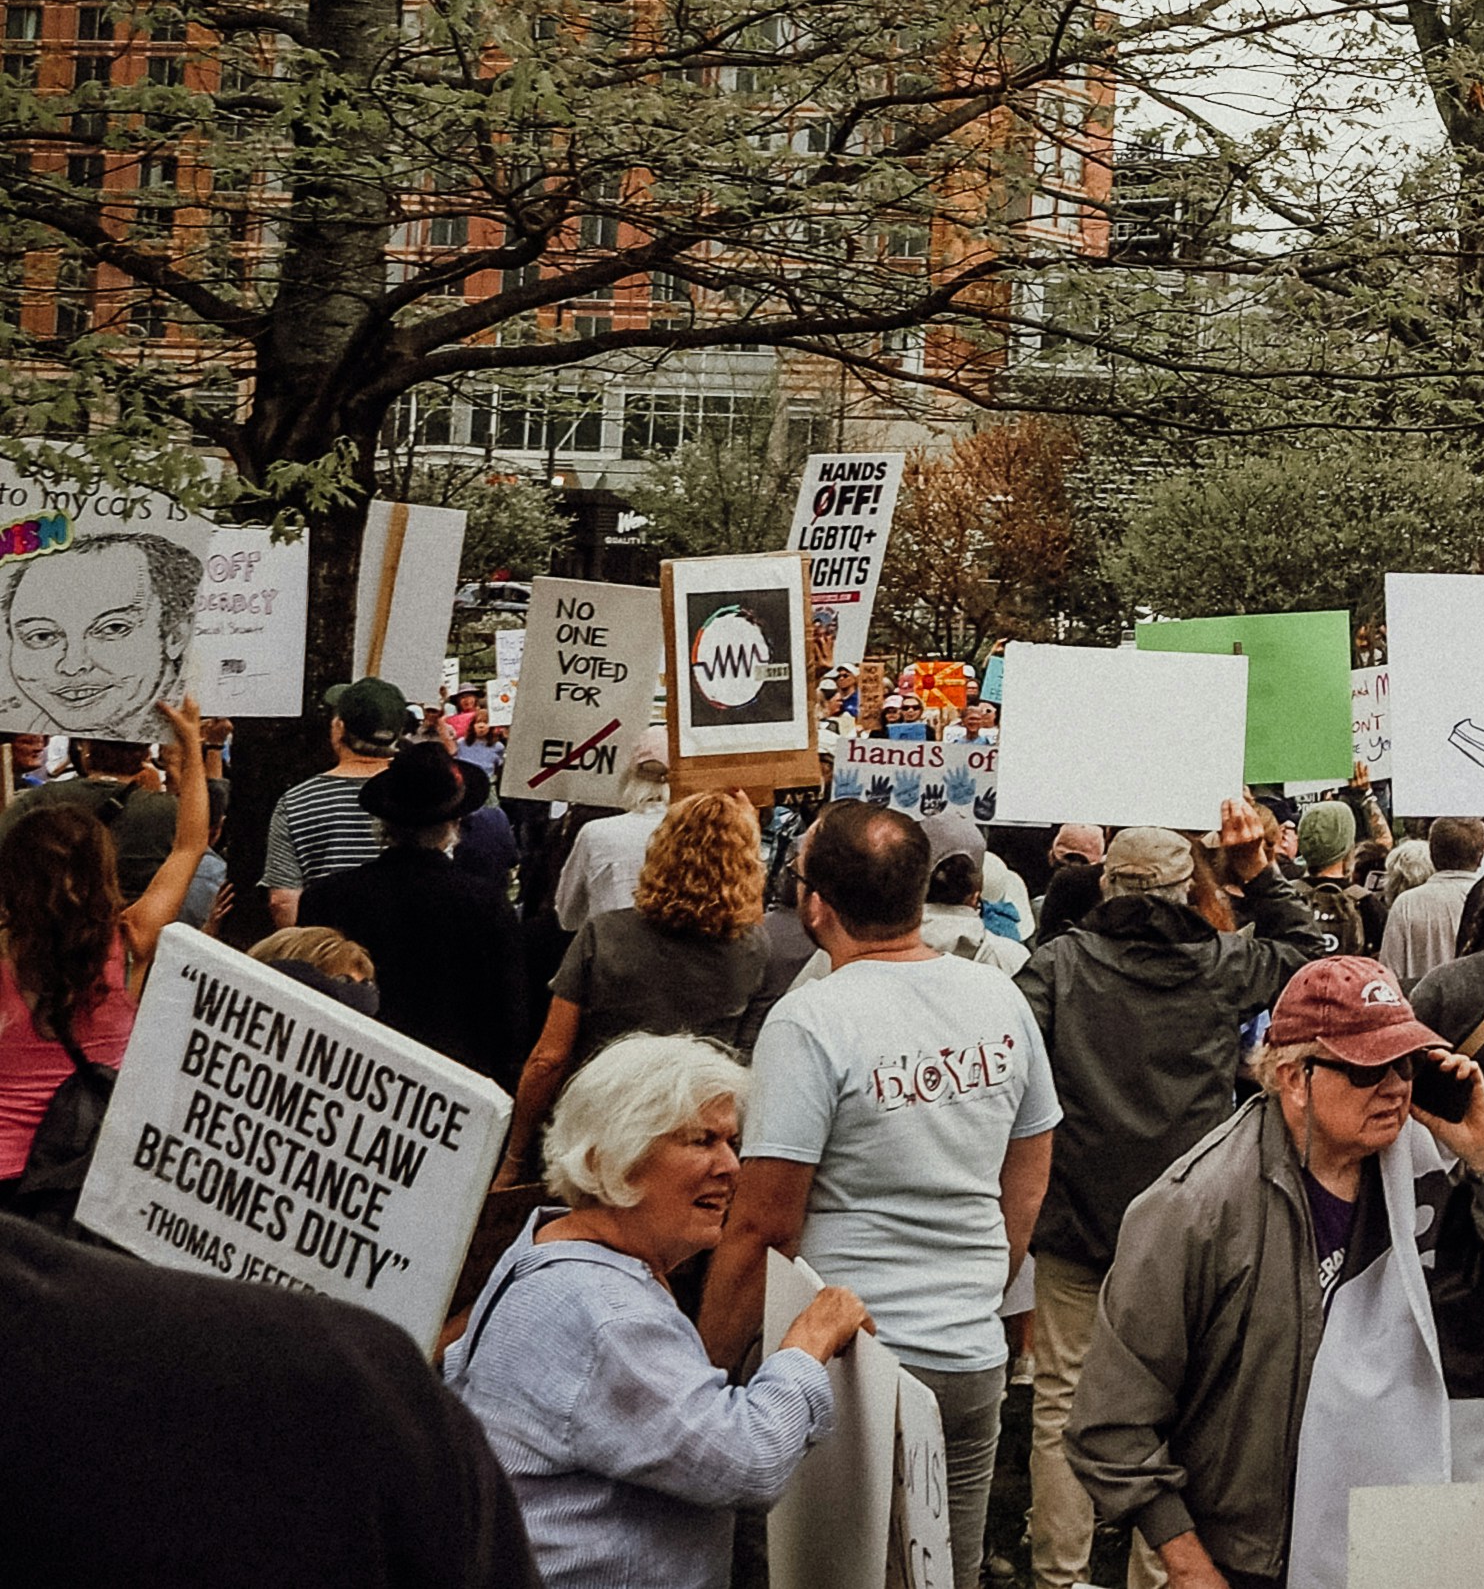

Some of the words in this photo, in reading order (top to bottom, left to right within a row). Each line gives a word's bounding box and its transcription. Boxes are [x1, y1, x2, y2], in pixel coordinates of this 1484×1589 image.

[818, 462, 888, 482] HANDS
[41, 490, 88, 522] my
[813, 485, 884, 517] OFF!
[800, 525, 877, 551] LGBTQ+
[207, 551, 261, 583] OFF
[808, 556, 871, 587] IGHTS
[556, 598, 594, 621] NO
[556, 624, 609, 647] ONE
[558, 650, 628, 683] VOTED
[555, 682, 601, 708] FOR
[540, 740, 617, 774] ELON
[848, 739, 944, 769] hands
[296, 1029, 470, 1150] INJUSTICE
[180, 1030, 344, 1148] BECOMES
[345, 1113, 428, 1188] LAW
[184, 1090, 392, 1232] RESISTANCE
[133, 1123, 295, 1242] BECOMES
